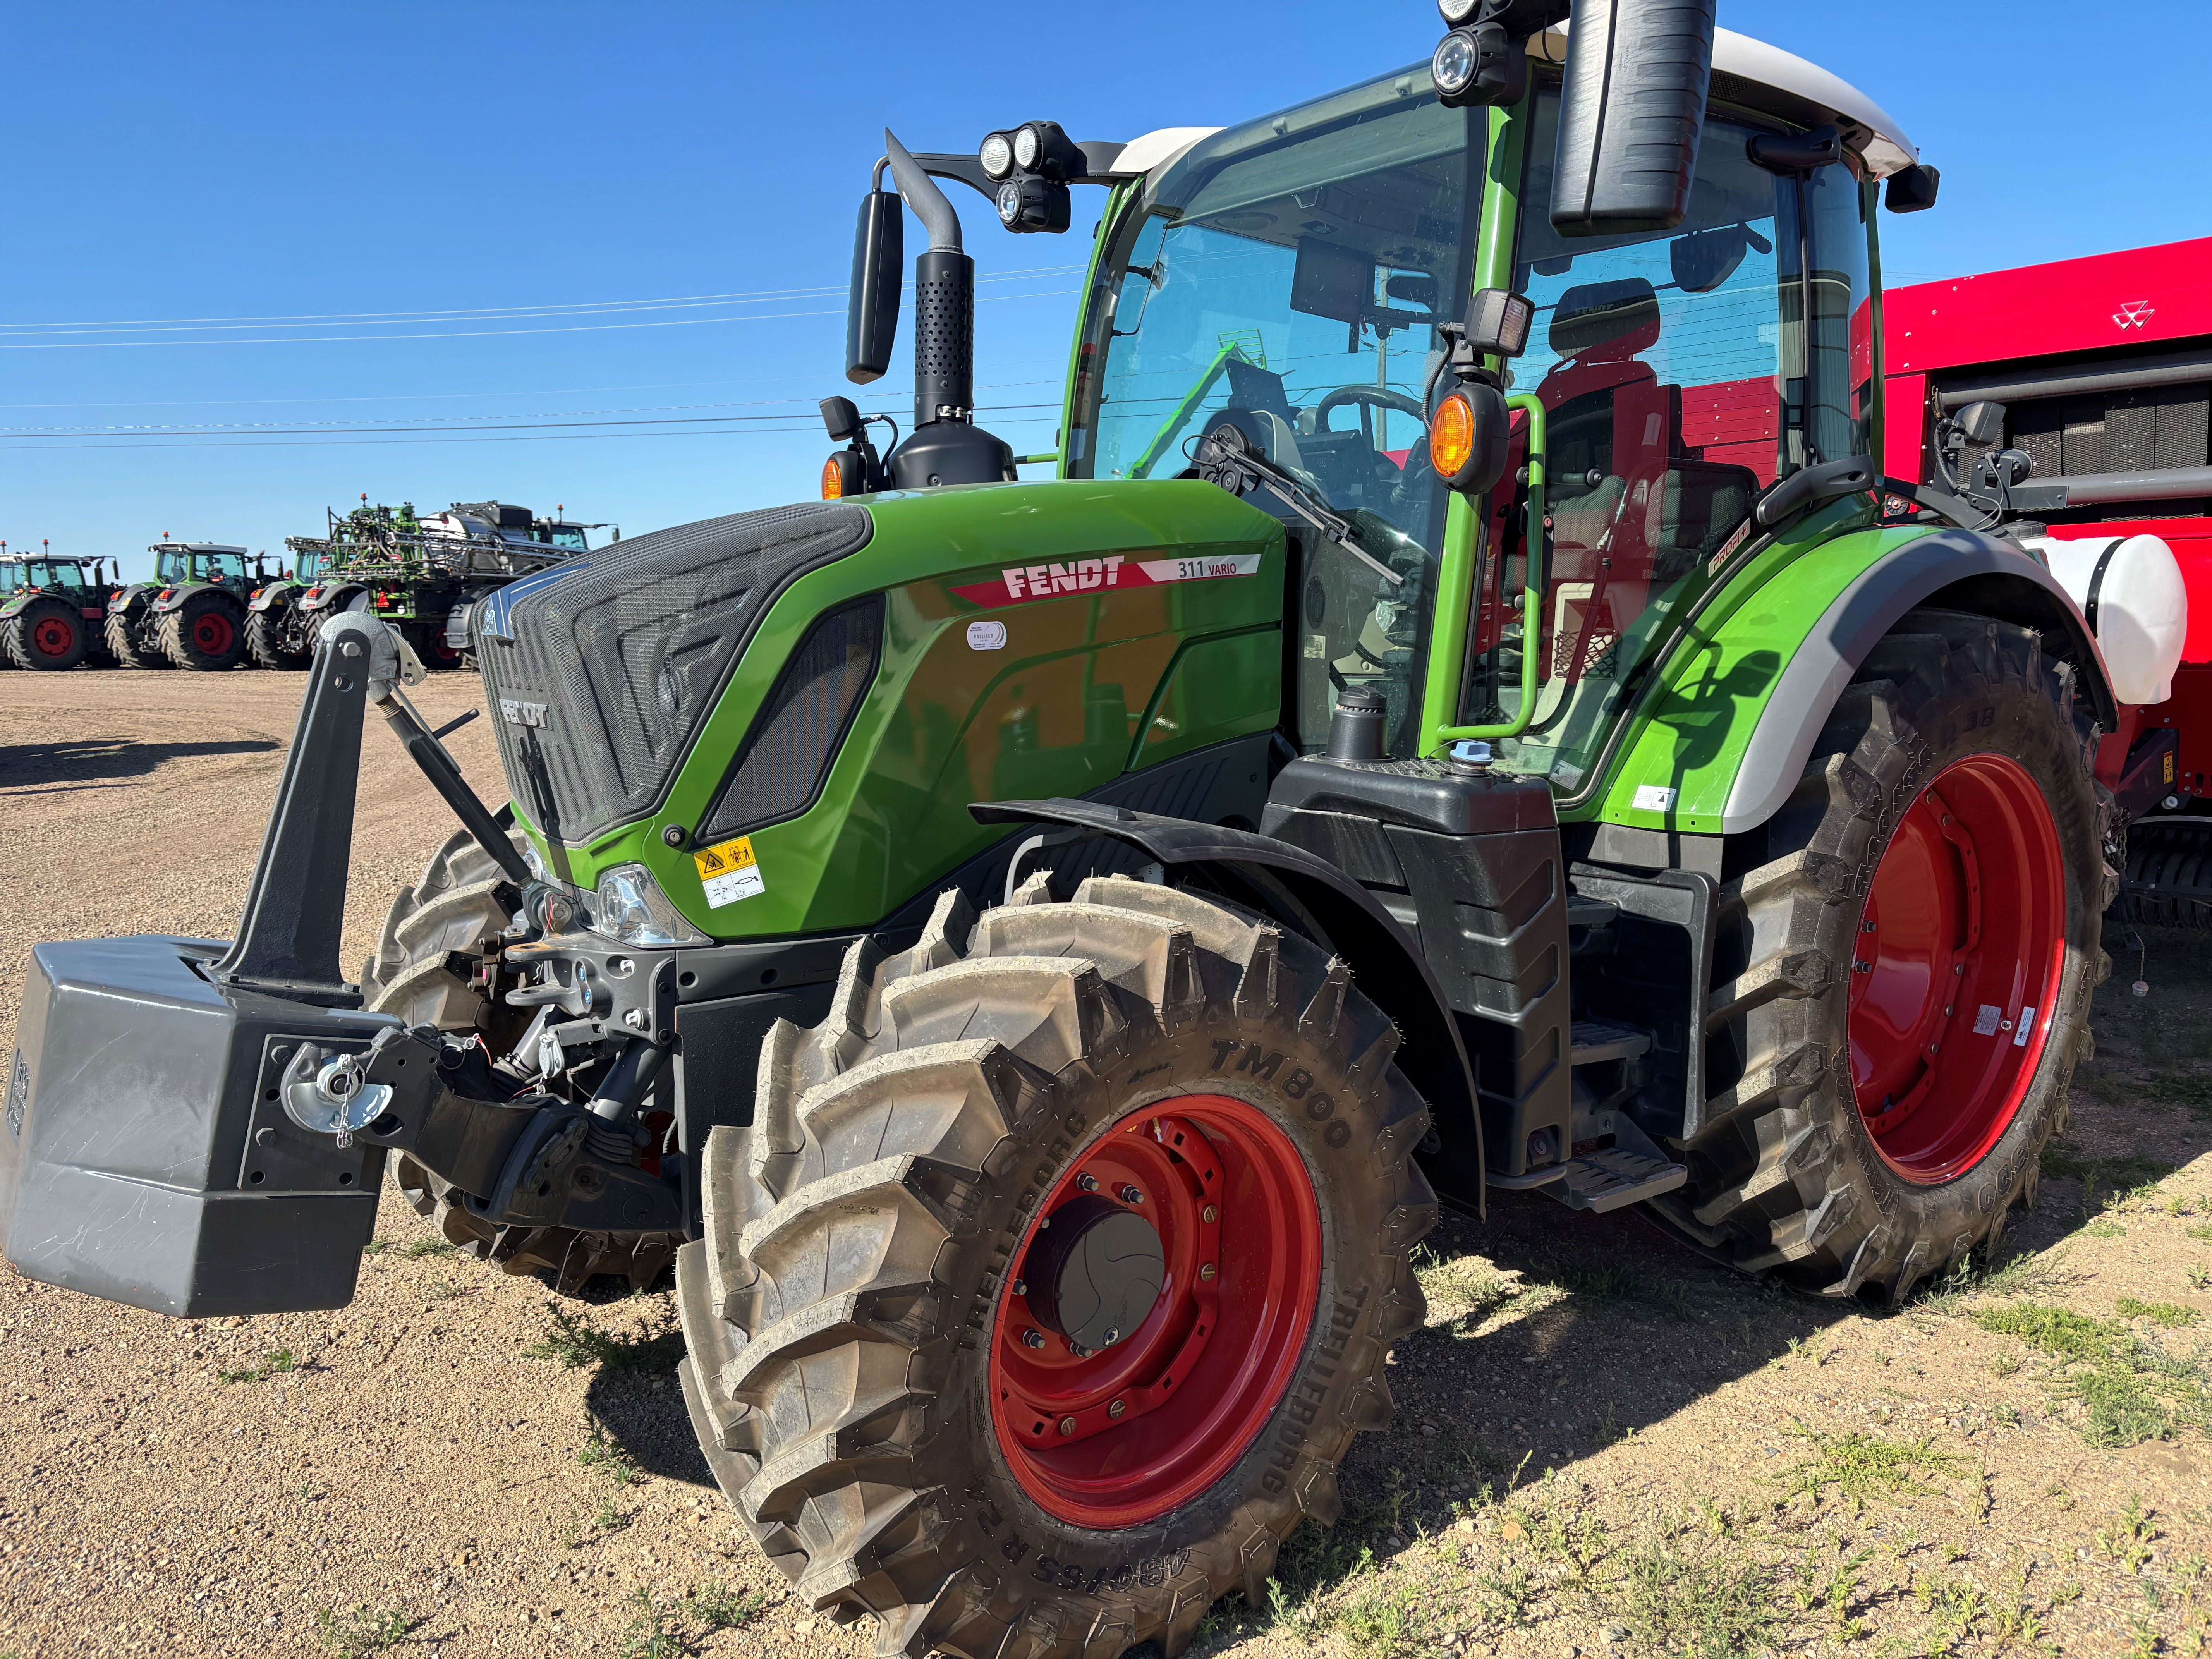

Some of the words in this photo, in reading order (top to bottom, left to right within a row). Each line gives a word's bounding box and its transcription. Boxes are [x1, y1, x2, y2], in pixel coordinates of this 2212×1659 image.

[1002, 555, 1125, 599] FENDT
[1178, 560, 1205, 579] 311
[1209, 562, 1237, 576] VARIO
[499, 699, 548, 728] FENDT
[1963, 706, 1996, 732] 38
[951, 1109, 1087, 1353] TRELLEBORG
[1262, 1286, 1369, 1494] TRELLEBORG
